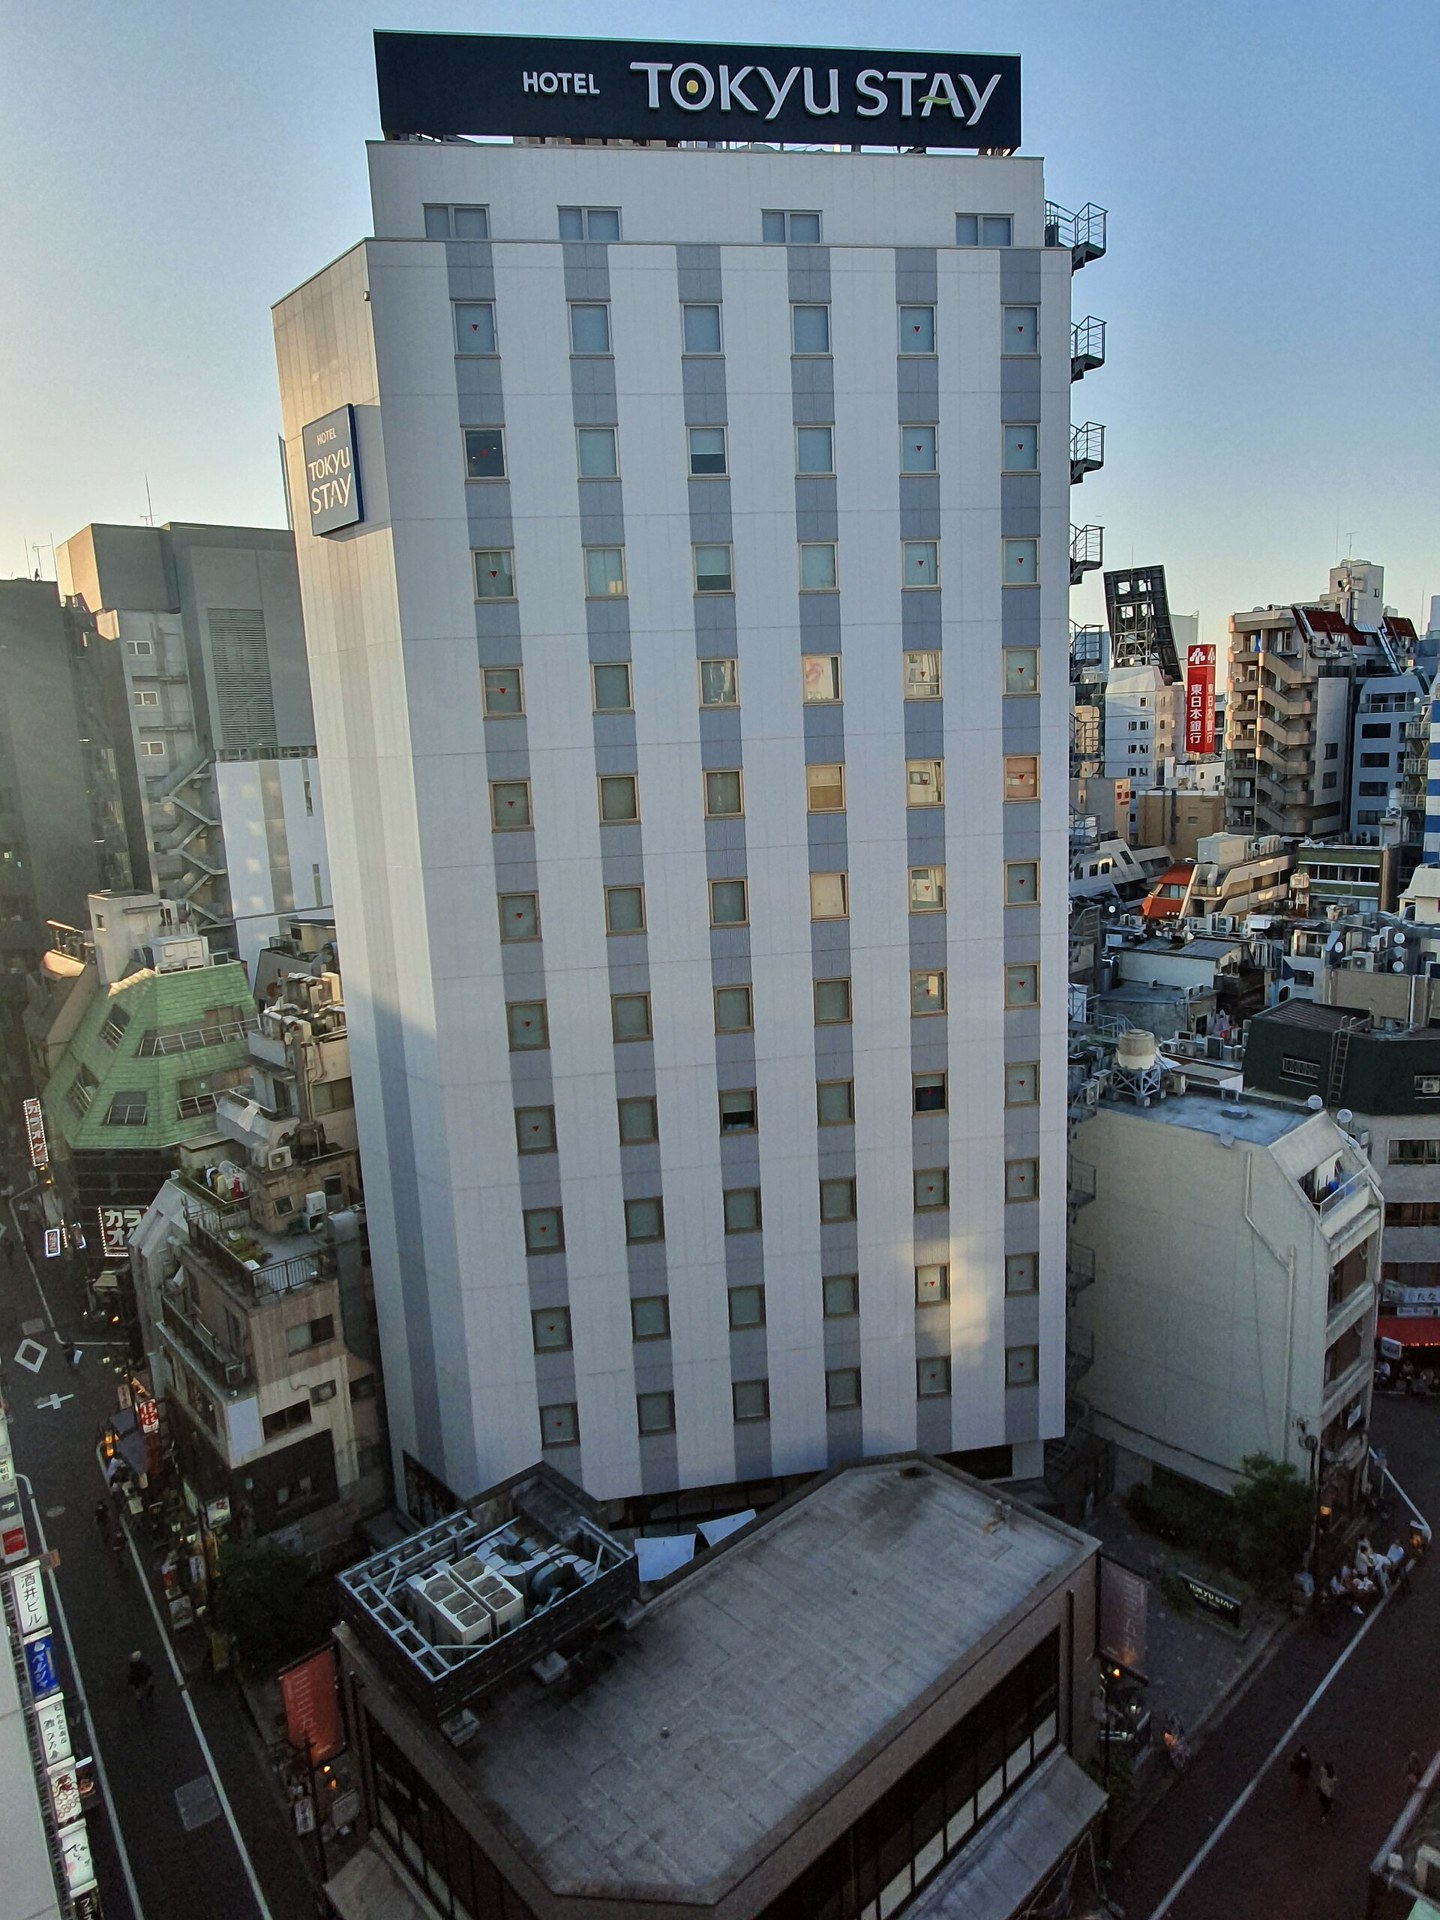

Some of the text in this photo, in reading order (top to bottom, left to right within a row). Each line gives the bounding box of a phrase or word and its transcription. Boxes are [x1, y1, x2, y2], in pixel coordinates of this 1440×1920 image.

[522, 61, 1002, 127] HOTEL TOKYU STAY
[316, 427, 337, 446] HOTEL
[308, 446, 351, 482] TOKYU
[311, 473, 352, 515] STAY
[1189, 684, 1203, 744] 東日本銀行
[104, 1209, 142, 1228] カラ
[20, 1572, 43, 1628] 酒井ビル
